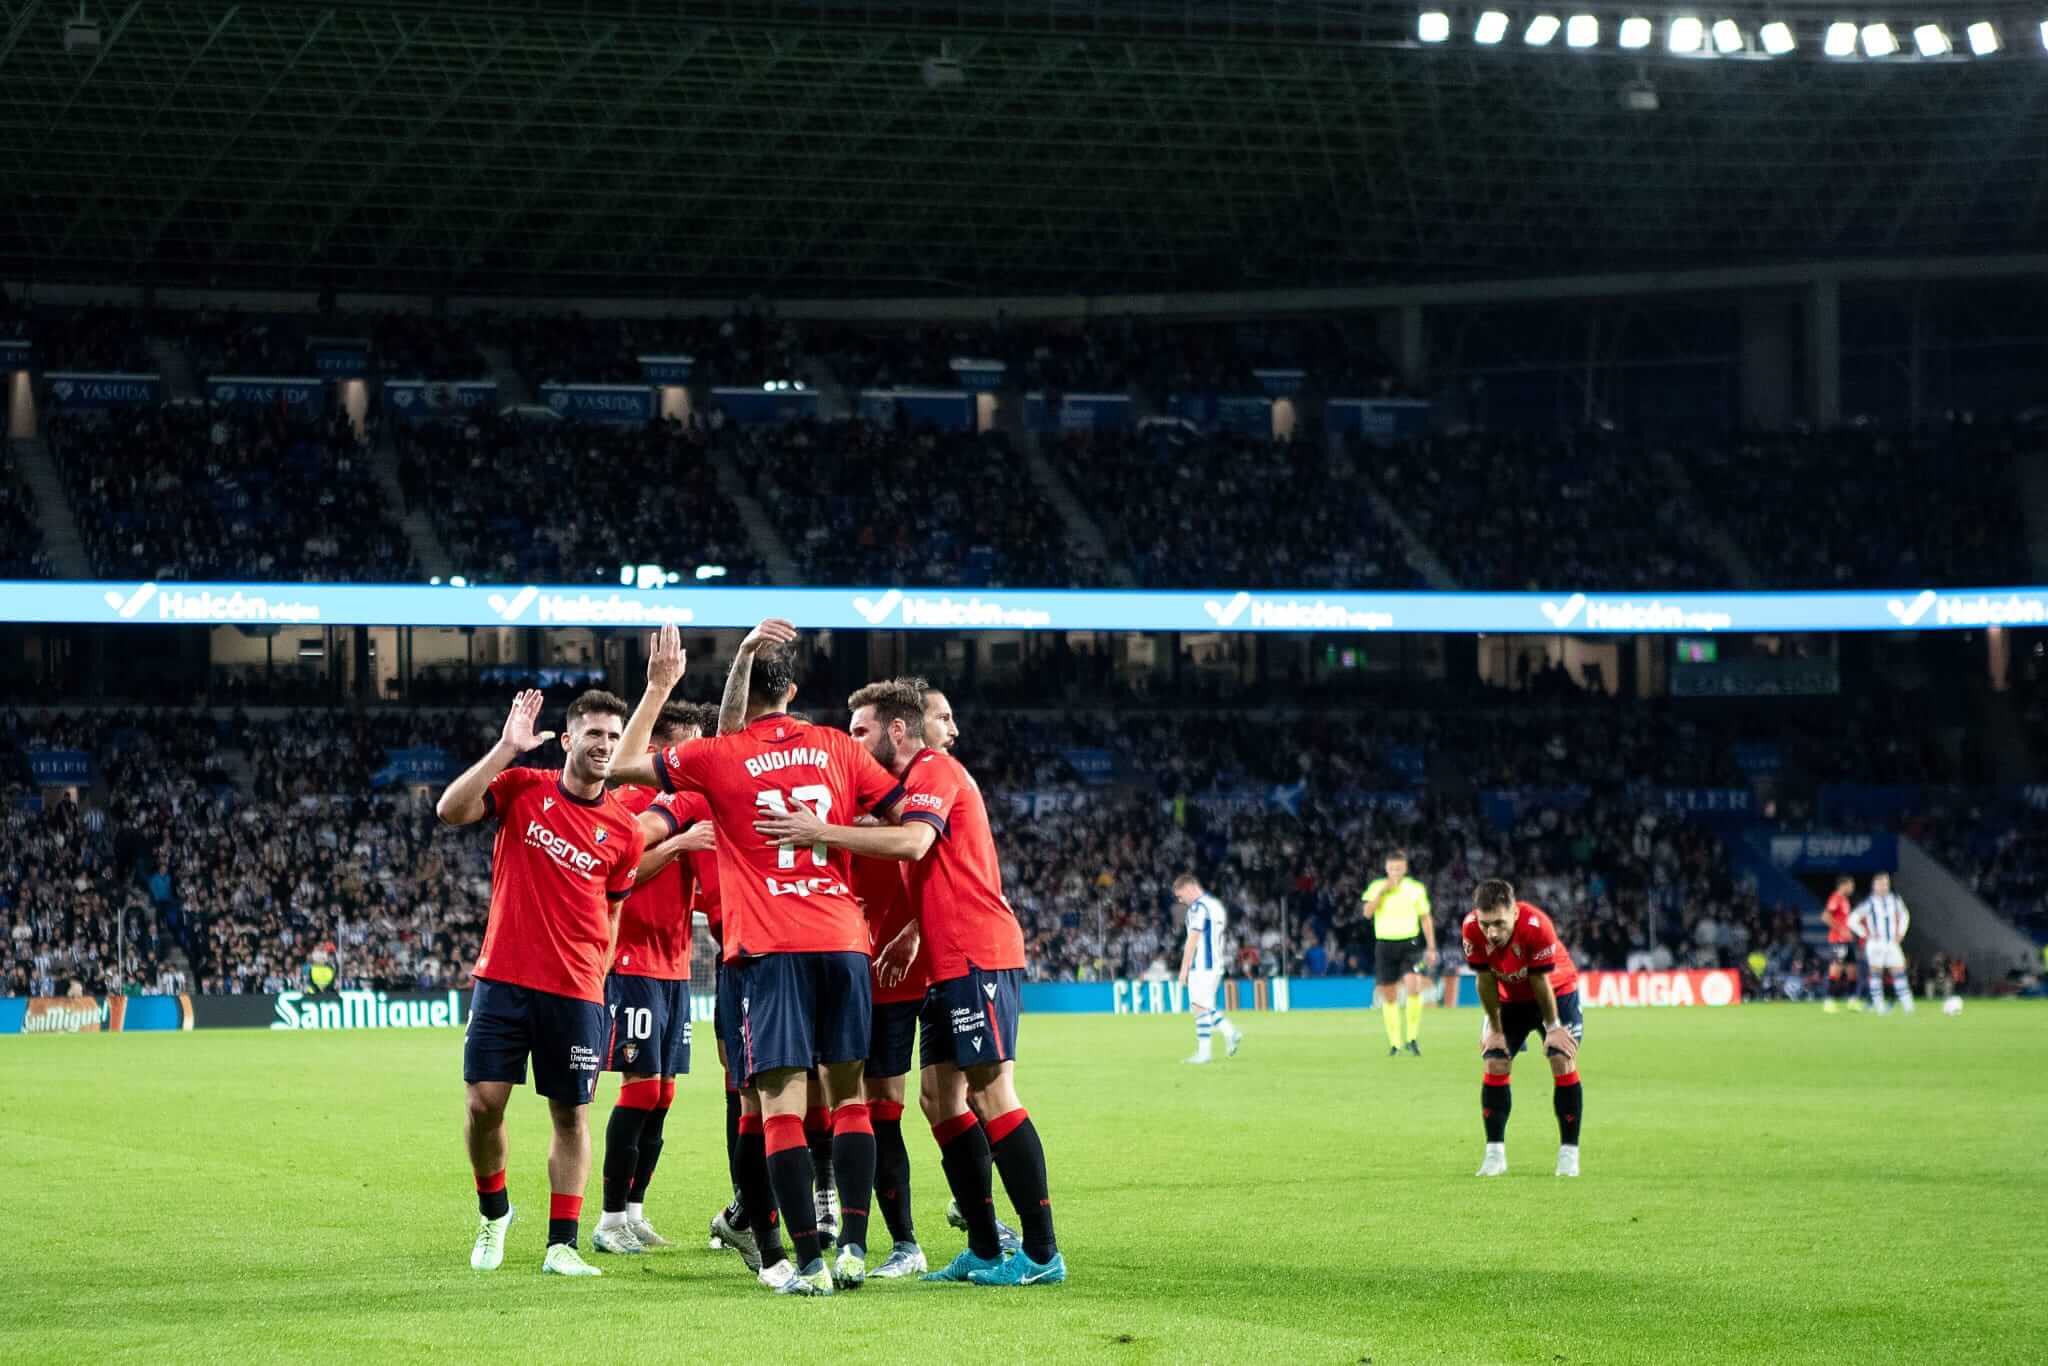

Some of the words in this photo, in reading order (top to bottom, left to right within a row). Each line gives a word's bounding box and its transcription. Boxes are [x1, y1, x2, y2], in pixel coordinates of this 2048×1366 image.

[159, 591, 267, 619] Halcón
[745, 747, 829, 777] BUDIMIR
[755, 784, 832, 868] 17
[1113, 979, 1185, 1014] CERV
[1578, 973, 1695, 1007] LALIGA
[624, 1007, 652, 1040] 10
